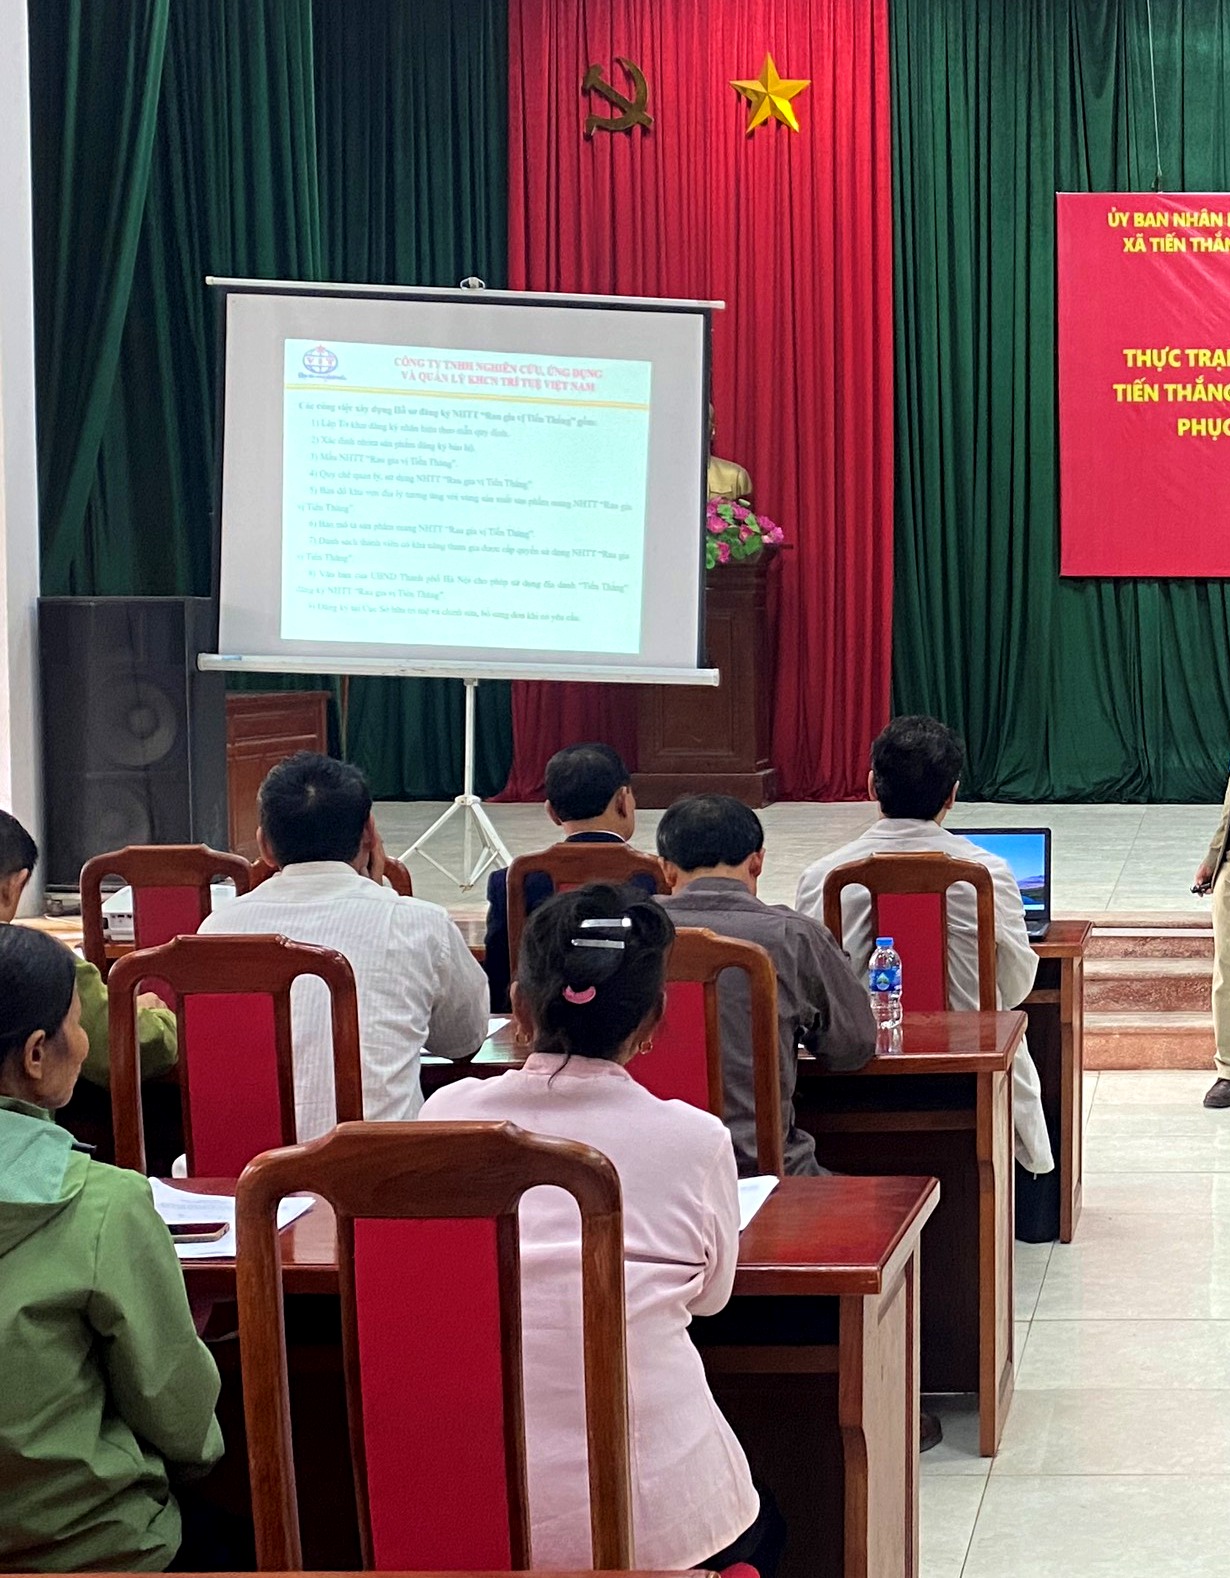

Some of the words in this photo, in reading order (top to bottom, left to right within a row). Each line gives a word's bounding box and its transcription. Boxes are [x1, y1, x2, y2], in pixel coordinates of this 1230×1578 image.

[1107, 206, 1131, 228] ỦY
[1133, 211, 1170, 228] BAN
[1172, 208, 1224, 228] NHÂN
[1122, 233, 1147, 253] XÃ
[1149, 232, 1187, 253] TIẾN
[394, 356, 425, 368] CÔNG
[428, 359, 441, 369] TY
[444, 360, 474, 371] TNHH
[475, 361, 518, 374] NGHIÊN
[572, 368, 603, 381] DỤNG
[1122, 345, 1182, 372] THỰC
[402, 370, 416, 381] VÀ
[418, 371, 449, 383] QUẢN
[570, 381, 596, 391] NAM
[1112, 377, 1160, 403] TIẾN
